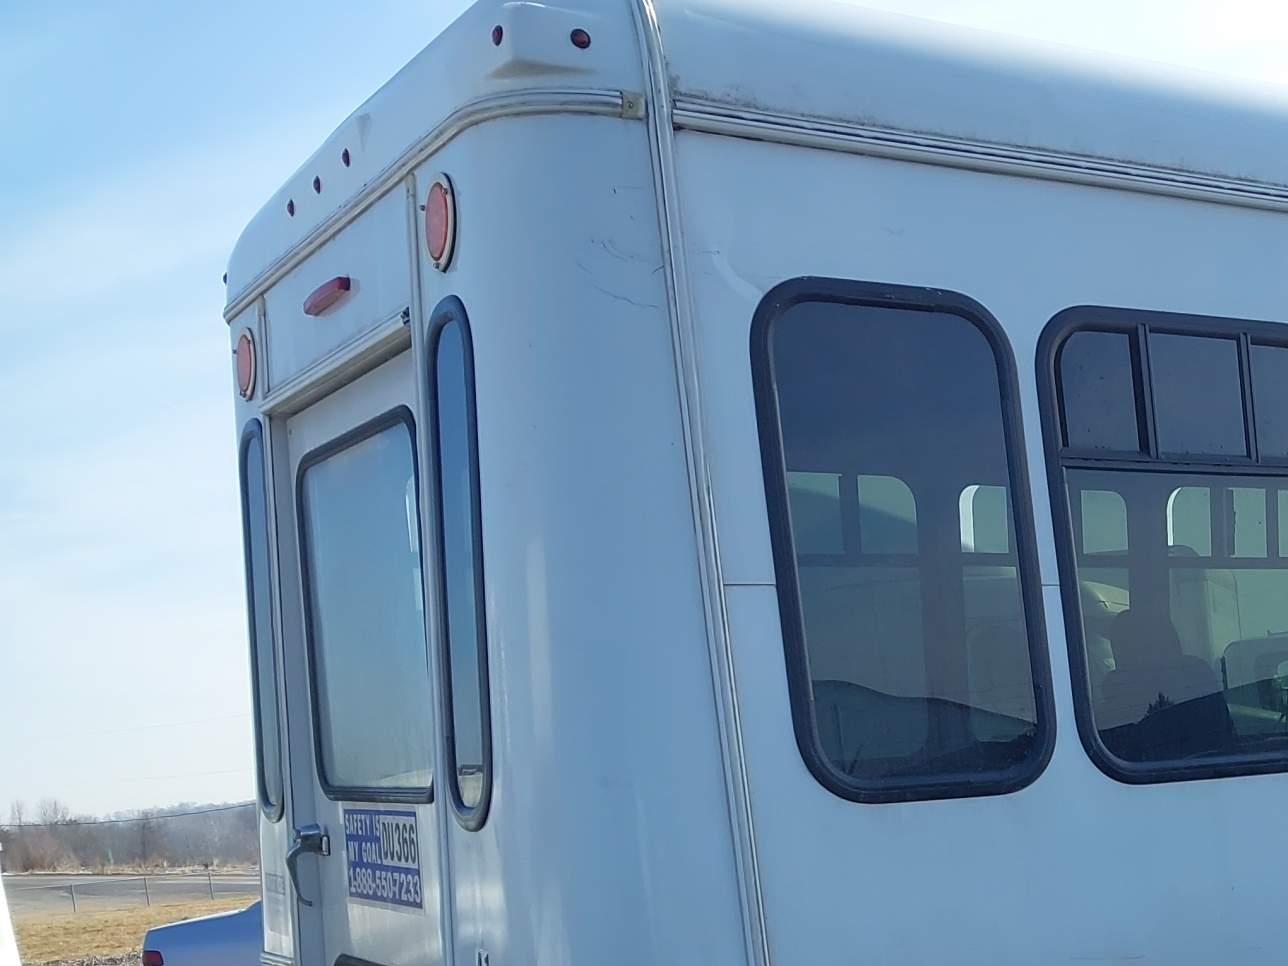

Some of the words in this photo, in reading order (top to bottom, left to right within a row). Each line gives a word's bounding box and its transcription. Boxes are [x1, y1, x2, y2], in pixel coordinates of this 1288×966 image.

[345, 813, 371, 837] SAFETY
[373, 815, 380, 837] IS
[348, 841, 359, 863] MY
[362, 842, 382, 865] GOAL
[381, 821, 416, 864] DU366
